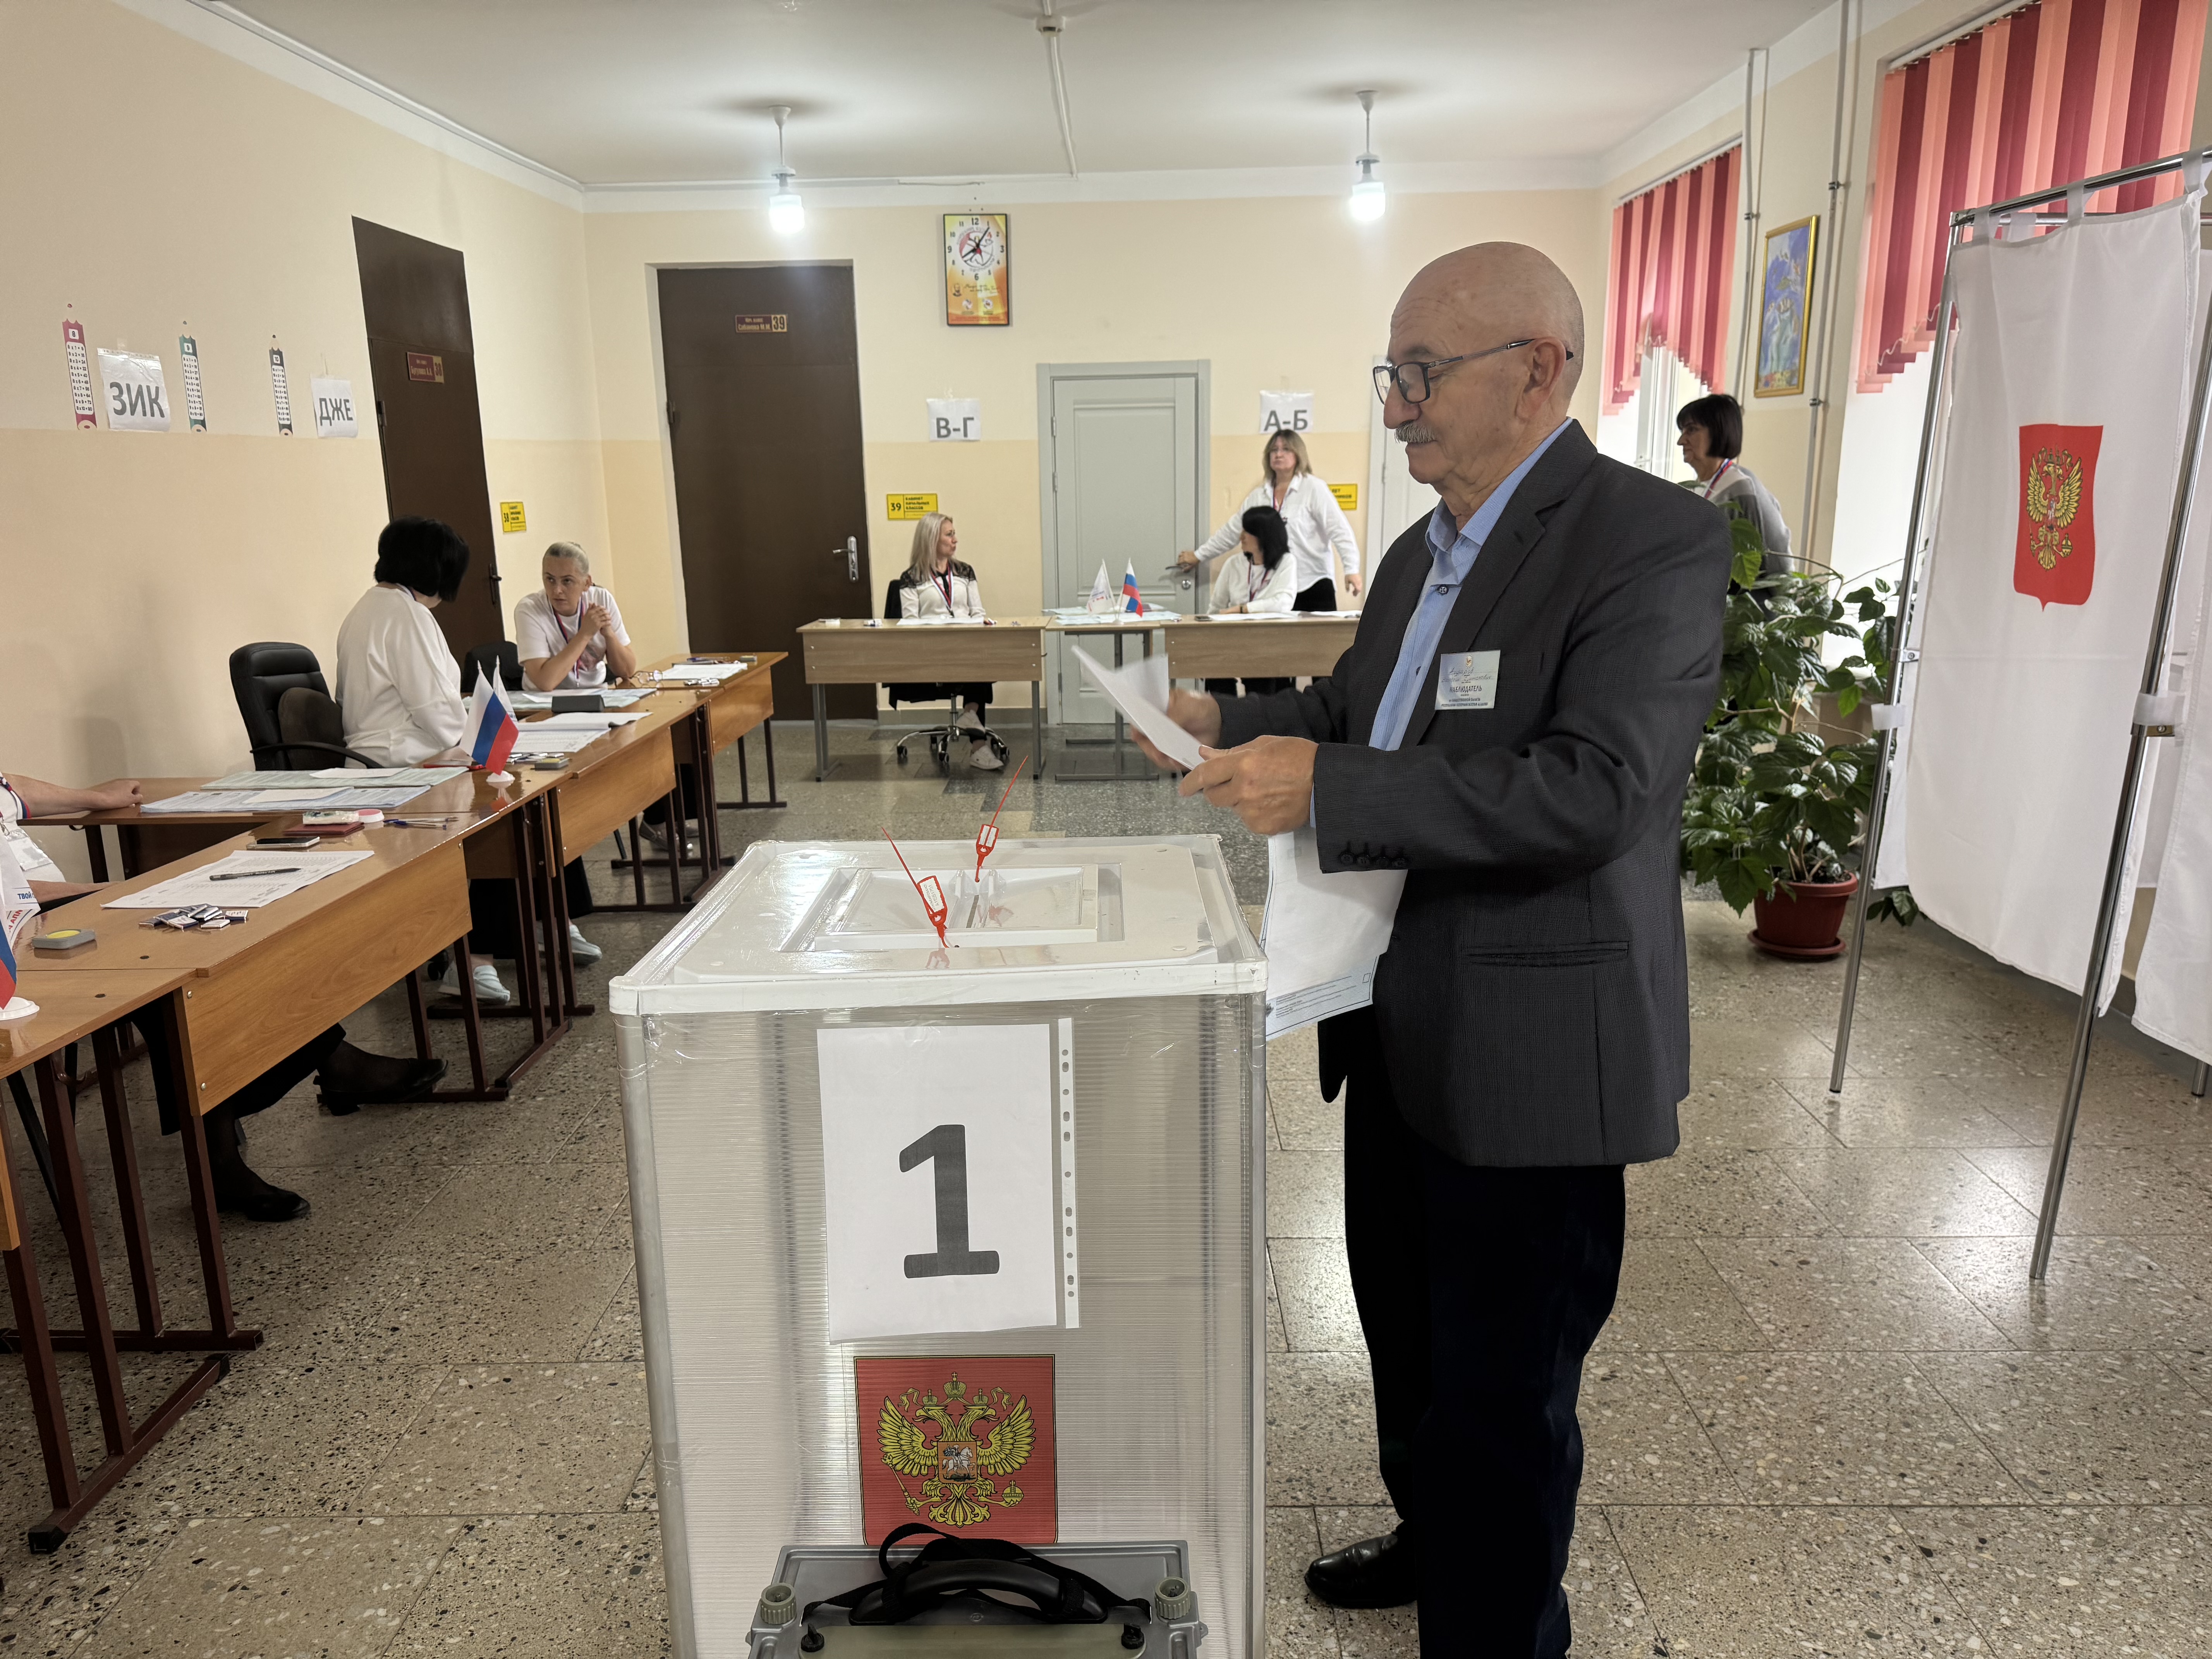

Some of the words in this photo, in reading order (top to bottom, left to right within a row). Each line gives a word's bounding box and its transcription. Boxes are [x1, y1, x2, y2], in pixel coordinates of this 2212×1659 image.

[773, 316, 785, 330] 39
[110, 381, 165, 418] ЗИК
[319, 398, 353, 426] ДЖЕ
[1264, 410, 1308, 431] А-Б
[936, 417, 974, 438] В-Г
[891, 503, 902, 511] 39
[899, 1124, 1000, 1278] 1
